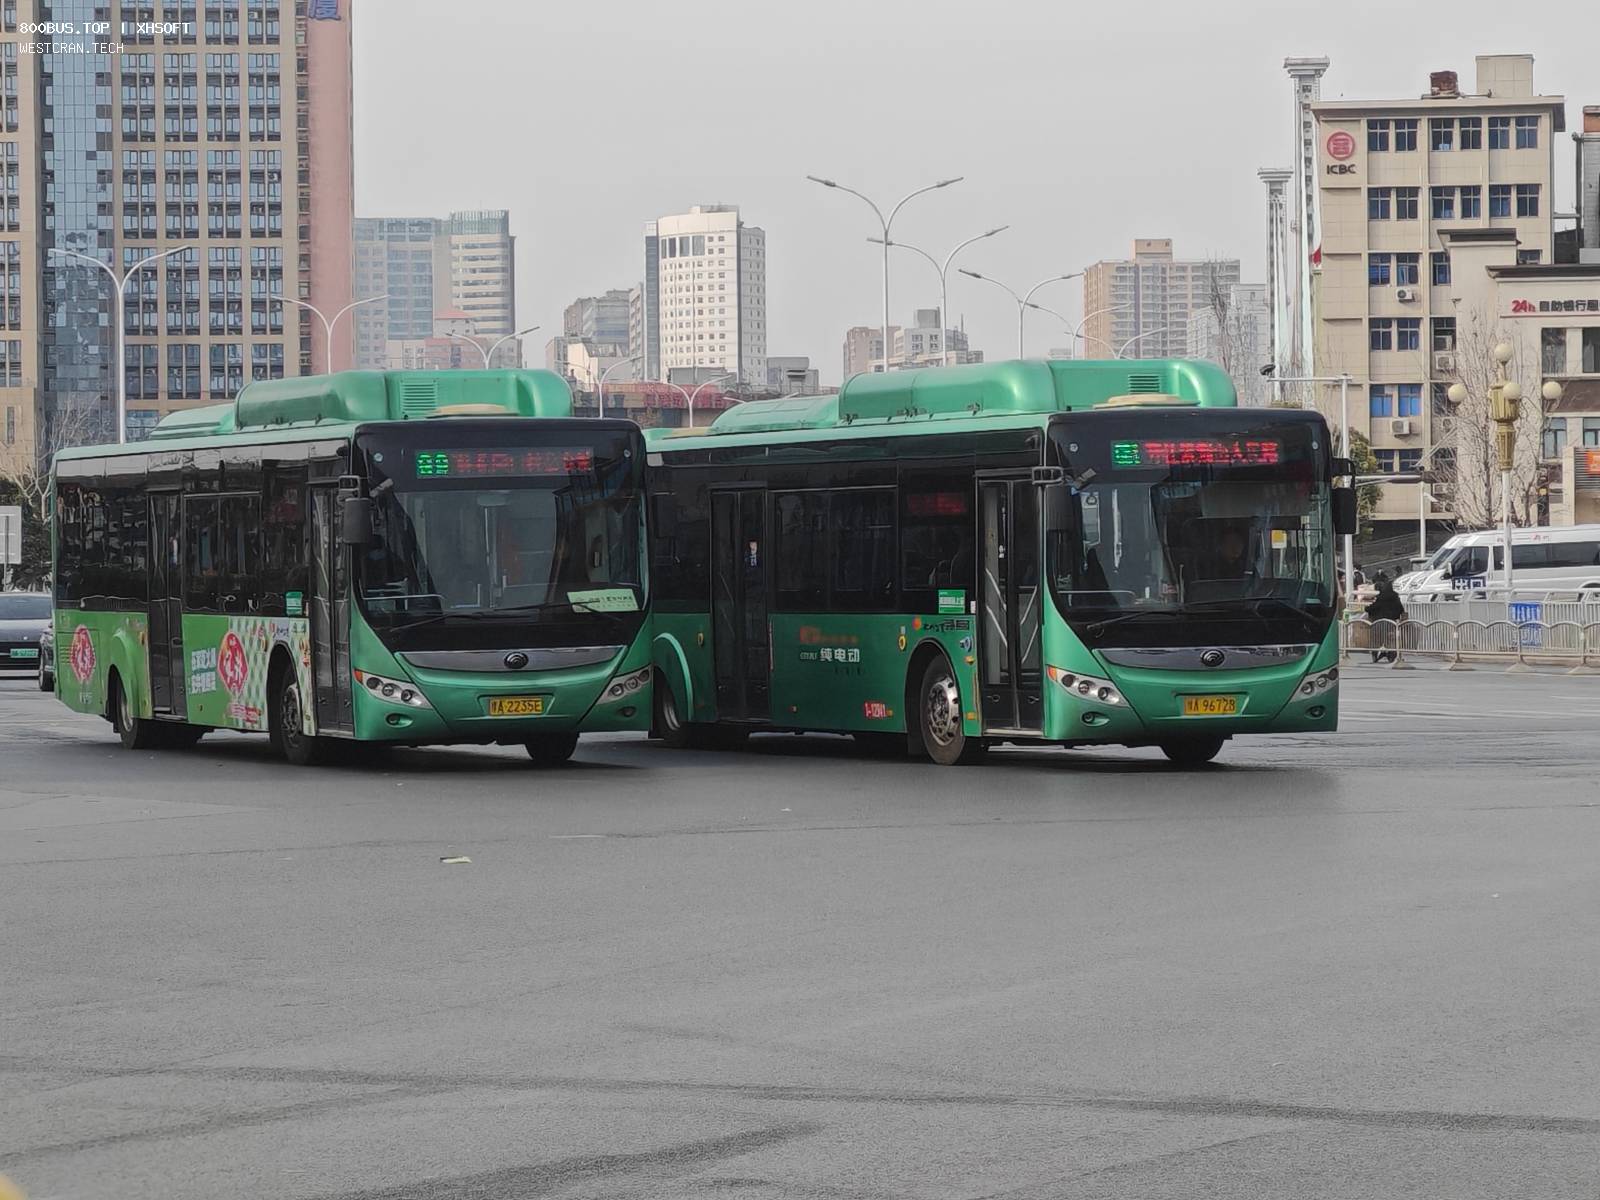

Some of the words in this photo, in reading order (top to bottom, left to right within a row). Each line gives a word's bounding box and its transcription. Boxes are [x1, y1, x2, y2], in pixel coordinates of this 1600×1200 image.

[1326, 164, 1356, 175] ICBC
[820, 648, 860, 663] 纯电动
